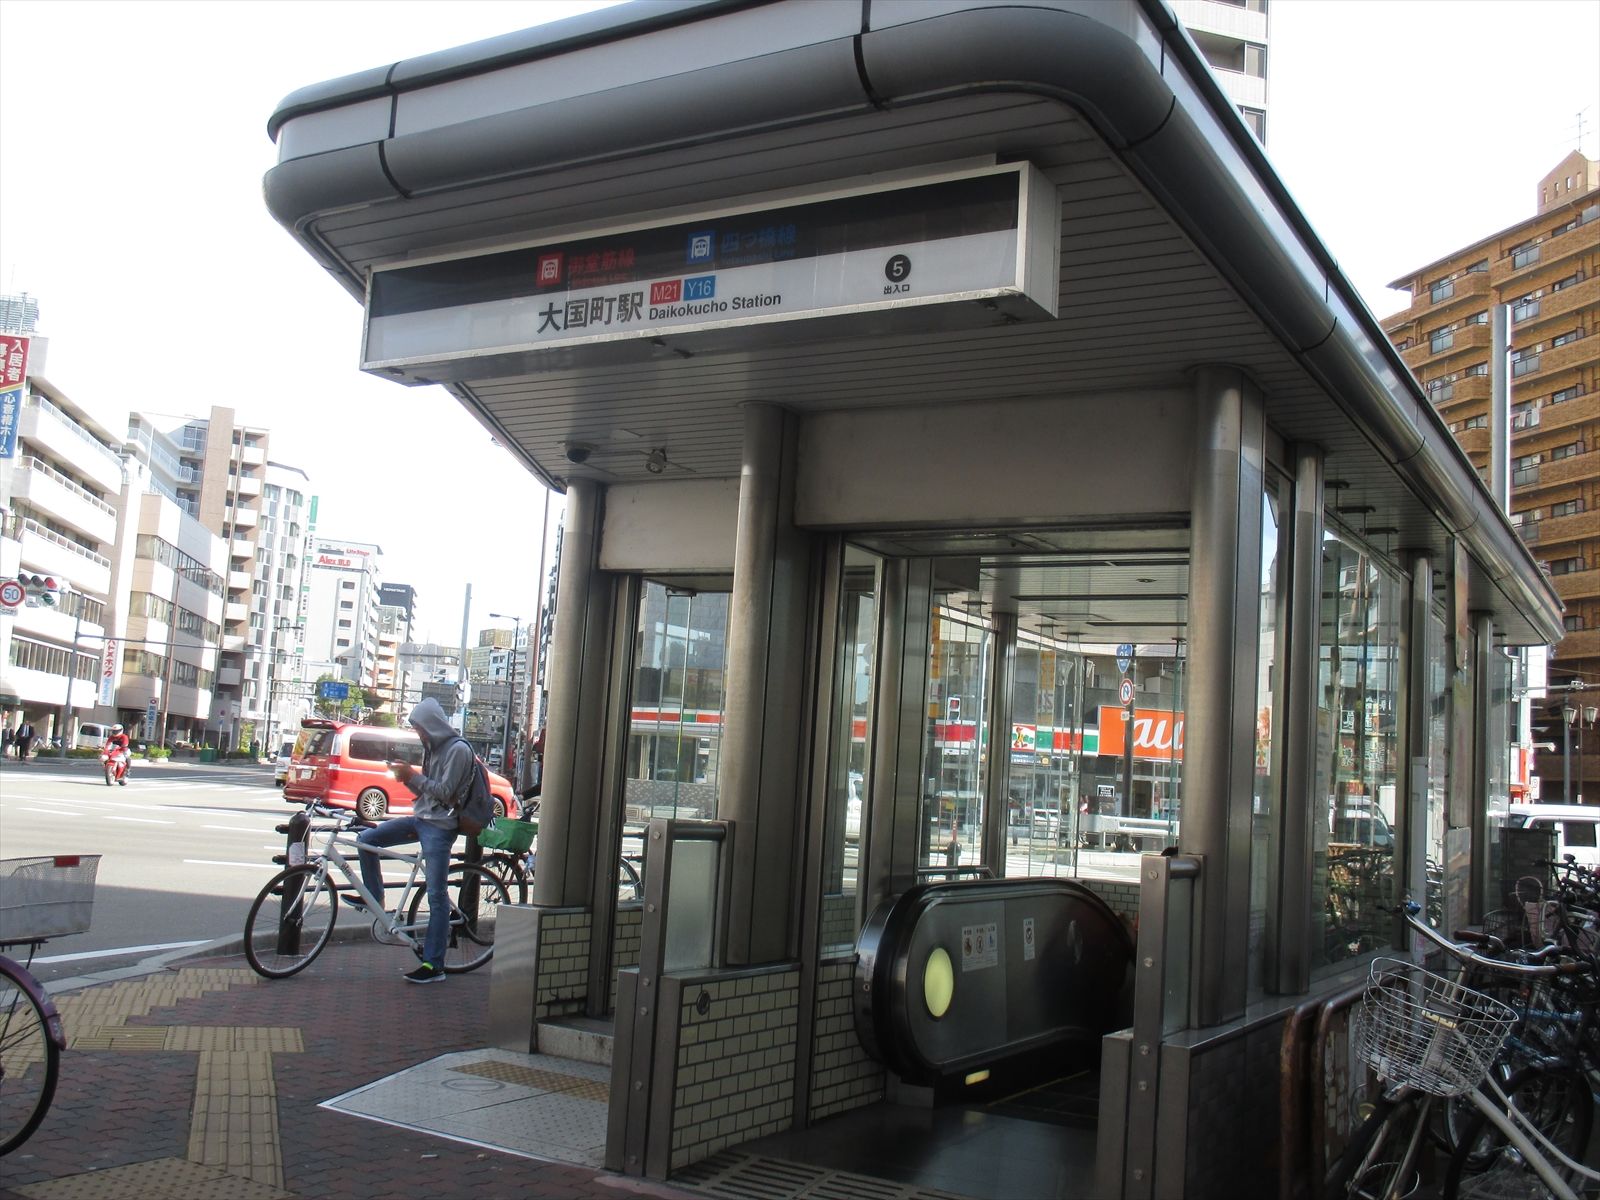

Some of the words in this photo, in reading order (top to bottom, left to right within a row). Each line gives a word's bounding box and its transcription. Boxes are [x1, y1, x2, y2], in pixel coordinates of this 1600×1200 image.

[892, 260, 904, 277] 5
[653, 284, 678, 302] M21
[686, 279, 712, 298] Y16
[883, 284, 910, 295] 出入口
[536, 291, 644, 334] 大国町駅
[649, 301, 728, 321] Daikokucho
[731, 293, 782, 311] Station
[7, 339, 24, 382] 入居者
[4, 588, 19, 601] 50
[1132, 718, 1185, 750] au
